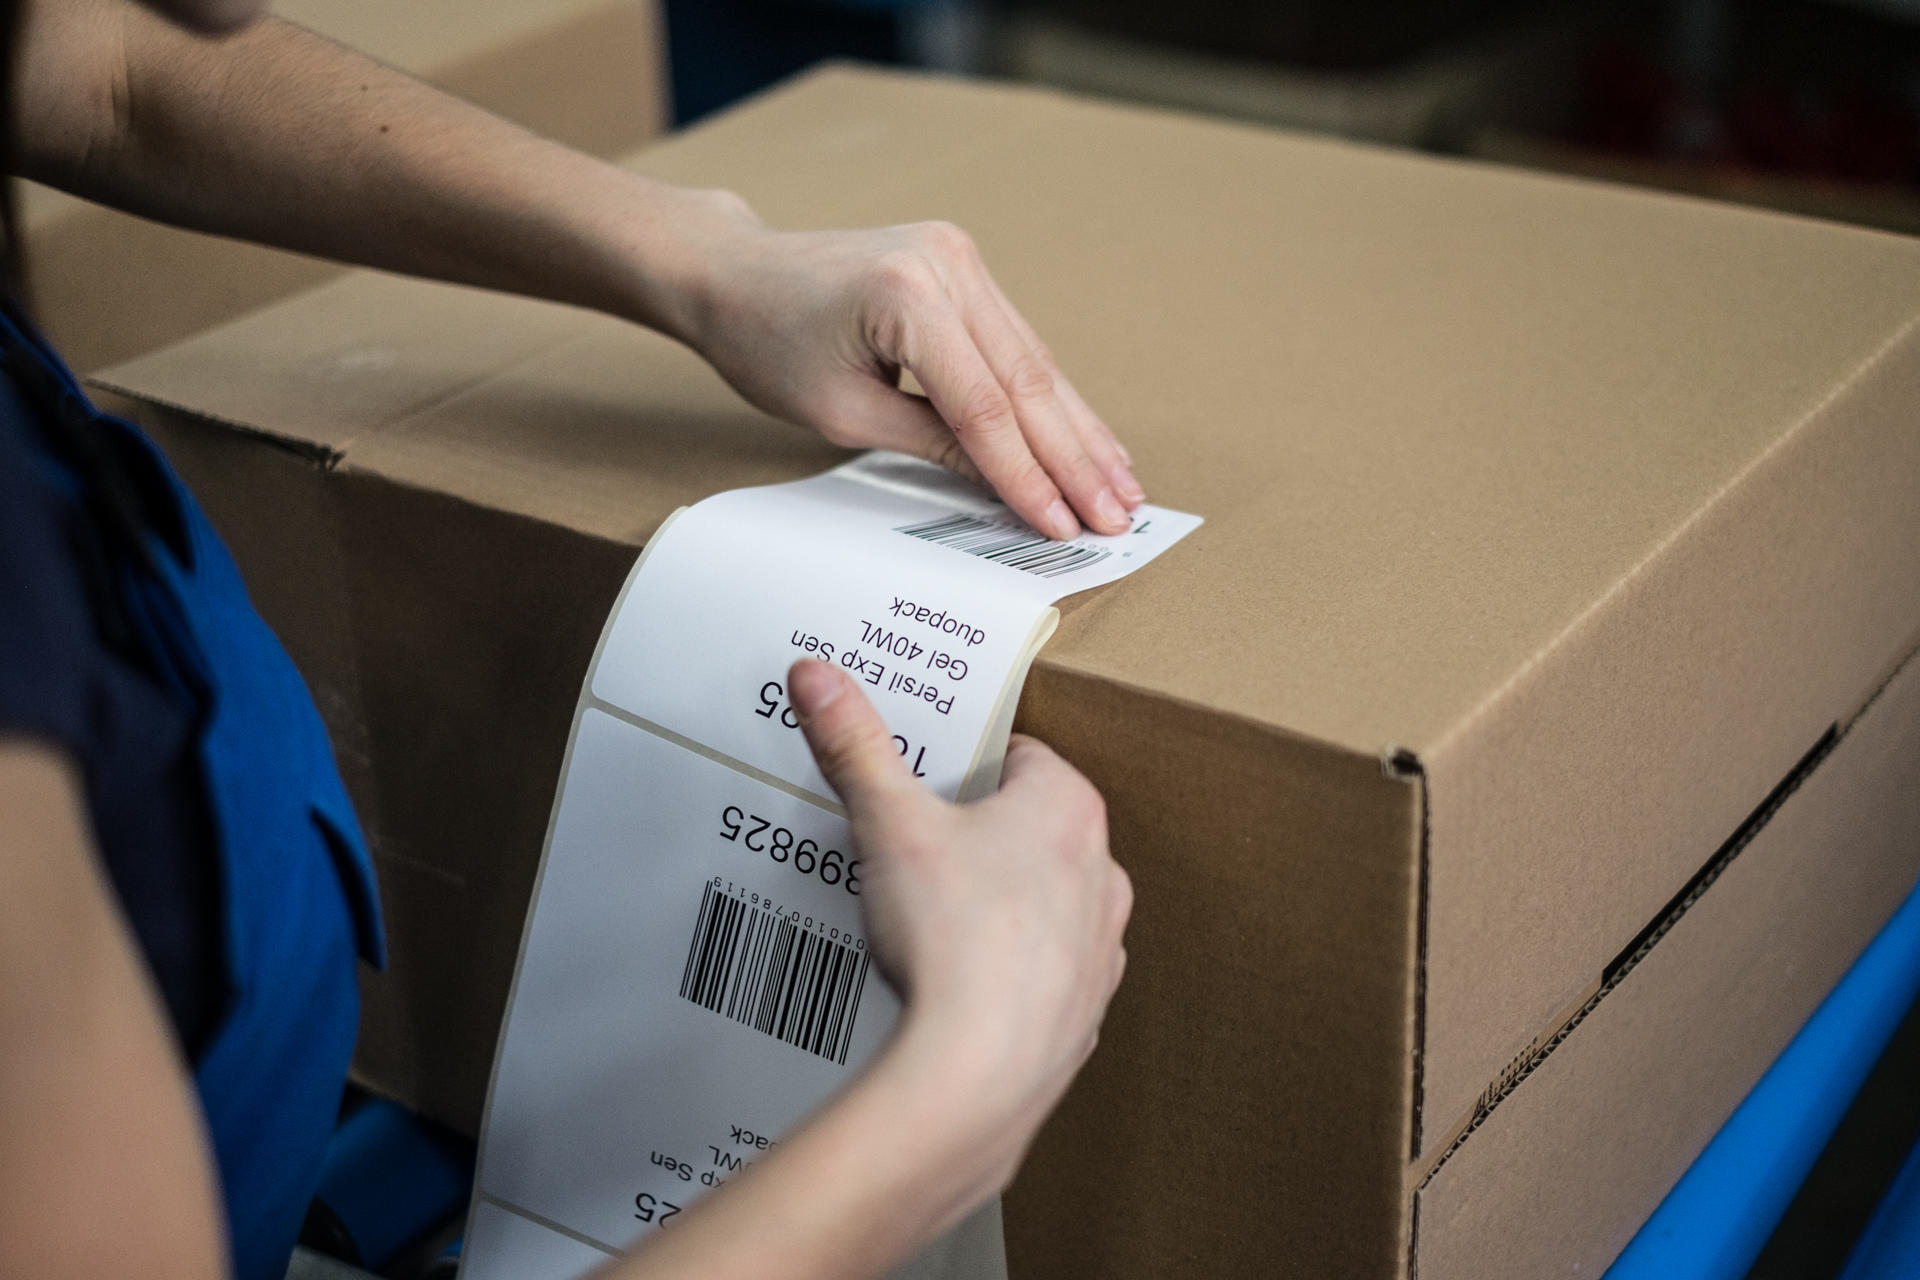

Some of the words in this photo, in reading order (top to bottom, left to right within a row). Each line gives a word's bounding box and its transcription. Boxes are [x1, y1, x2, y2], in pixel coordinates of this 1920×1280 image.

[888, 596, 985, 647] duopack
[791, 630, 835, 663] Sen
[860, 619, 924, 661] 40WL
[841, 649, 886, 685] Exp
[926, 650, 969, 681] Gel
[887, 671, 956, 715] Persil
[650, 1151, 694, 1182] Sen
